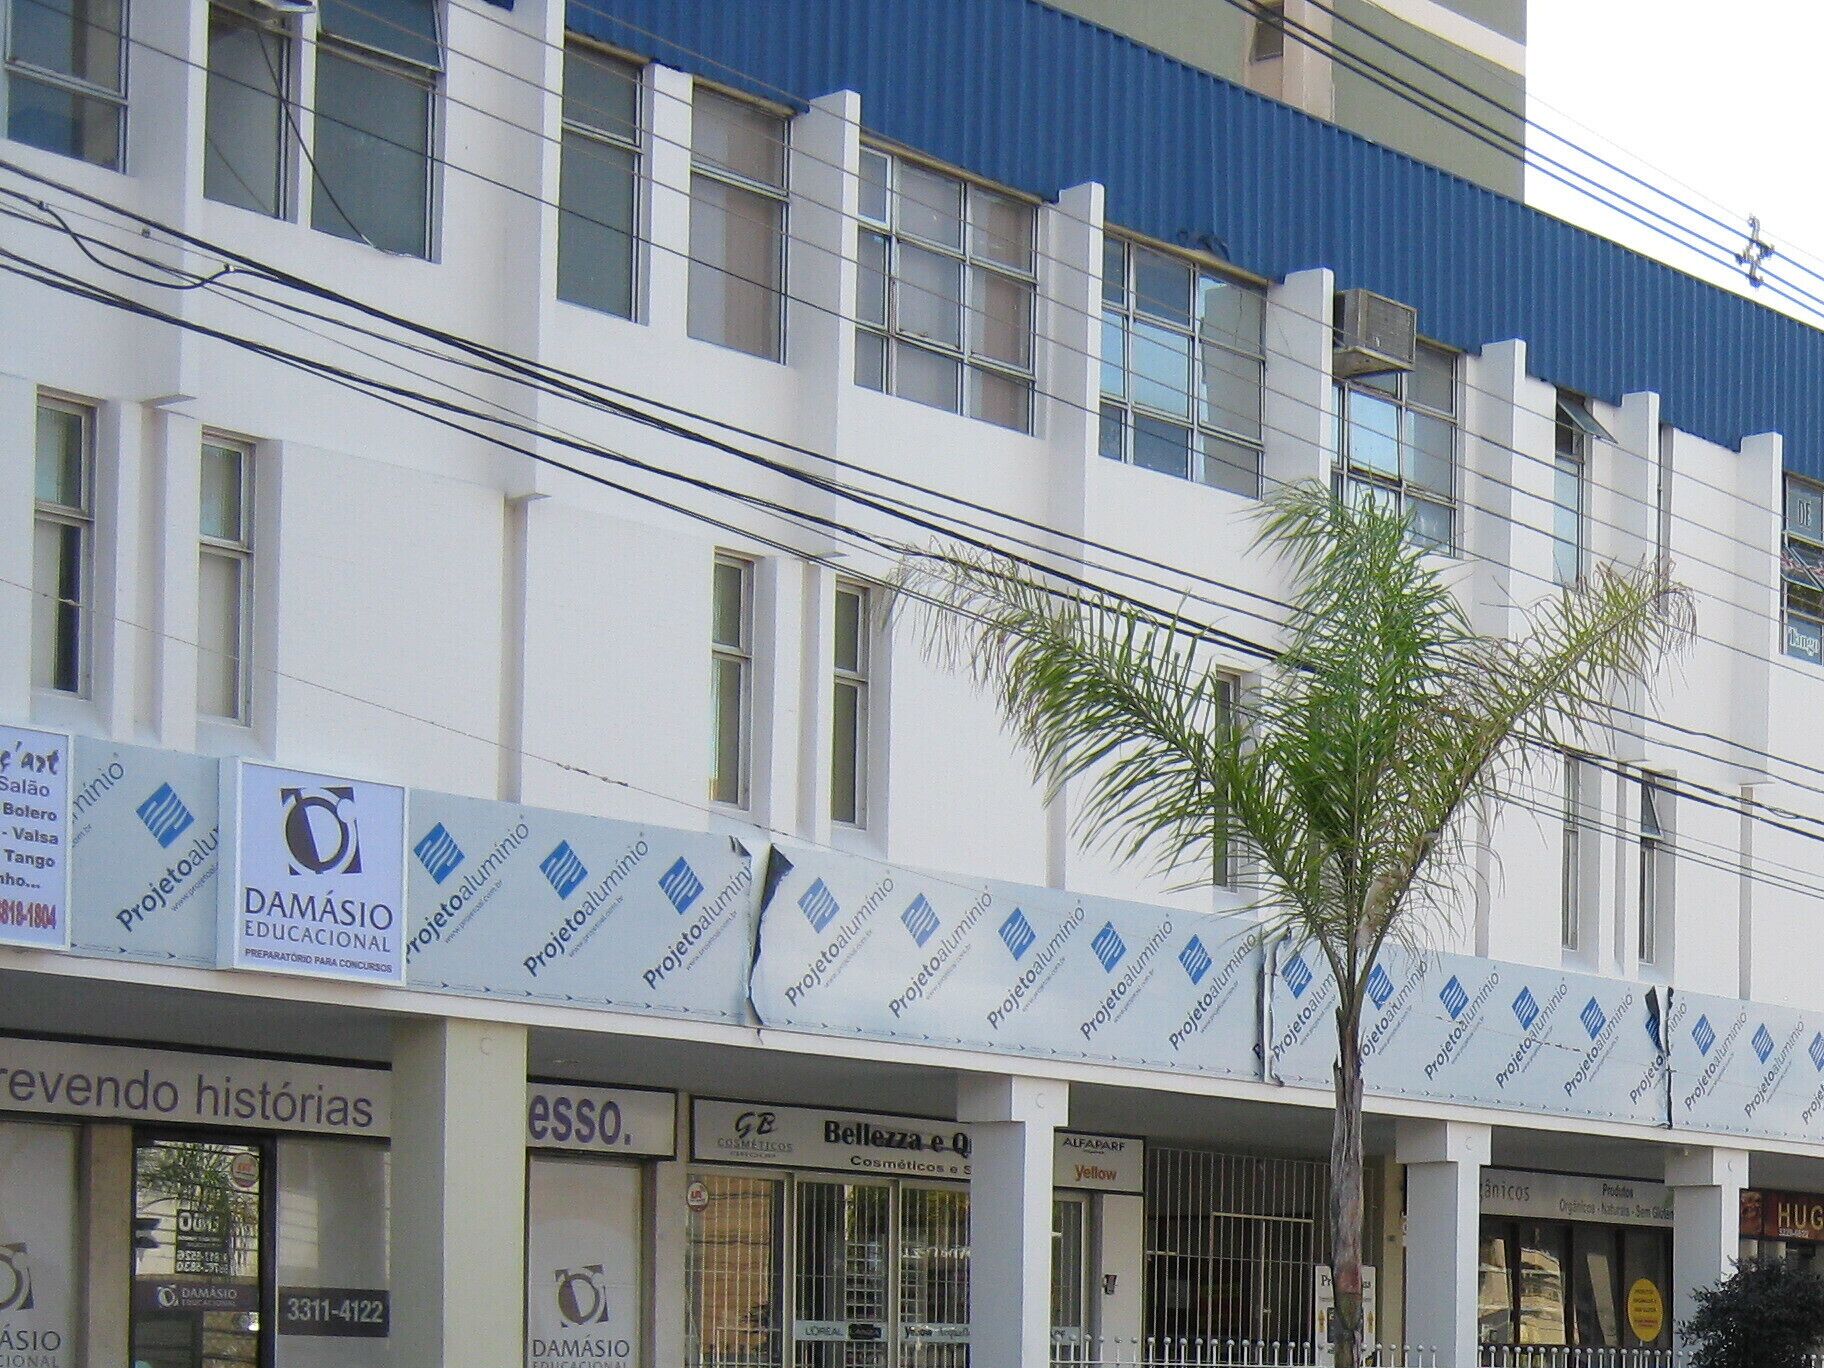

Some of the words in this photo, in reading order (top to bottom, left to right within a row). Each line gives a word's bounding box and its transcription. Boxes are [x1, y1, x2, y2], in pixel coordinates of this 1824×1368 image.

[3, 802, 58, 822] Bolero
[12, 826, 59, 845] Valsa
[4, 849, 56, 869] Tango
[244, 886, 394, 931] DAMÁSIO
[523, 839, 648, 977] Projetoalumínio
[244, 919, 391, 953] EDUCACIONAL
[785, 877, 894, 1007] Projetoalumínio
[314, 955, 338, 967] PARA
[339, 958, 393, 973] CONCURSOS
[889, 892, 992, 1018] Projetoalumínio
[195, 1074, 374, 1128] histórias
[528, 1094, 632, 1145] esso.
[824, 1120, 923, 1151] Bellezza
[931, 1135, 944, 1153] e
[1062, 1137, 1126, 1151] ALFAPARF
[850, 1155, 945, 1173] Cosméticos
[949, 1166, 959, 1175] e
[287, 1298, 383, 1322] 3311-4122
[532, 1333, 630, 1358] DAMÁSIO
